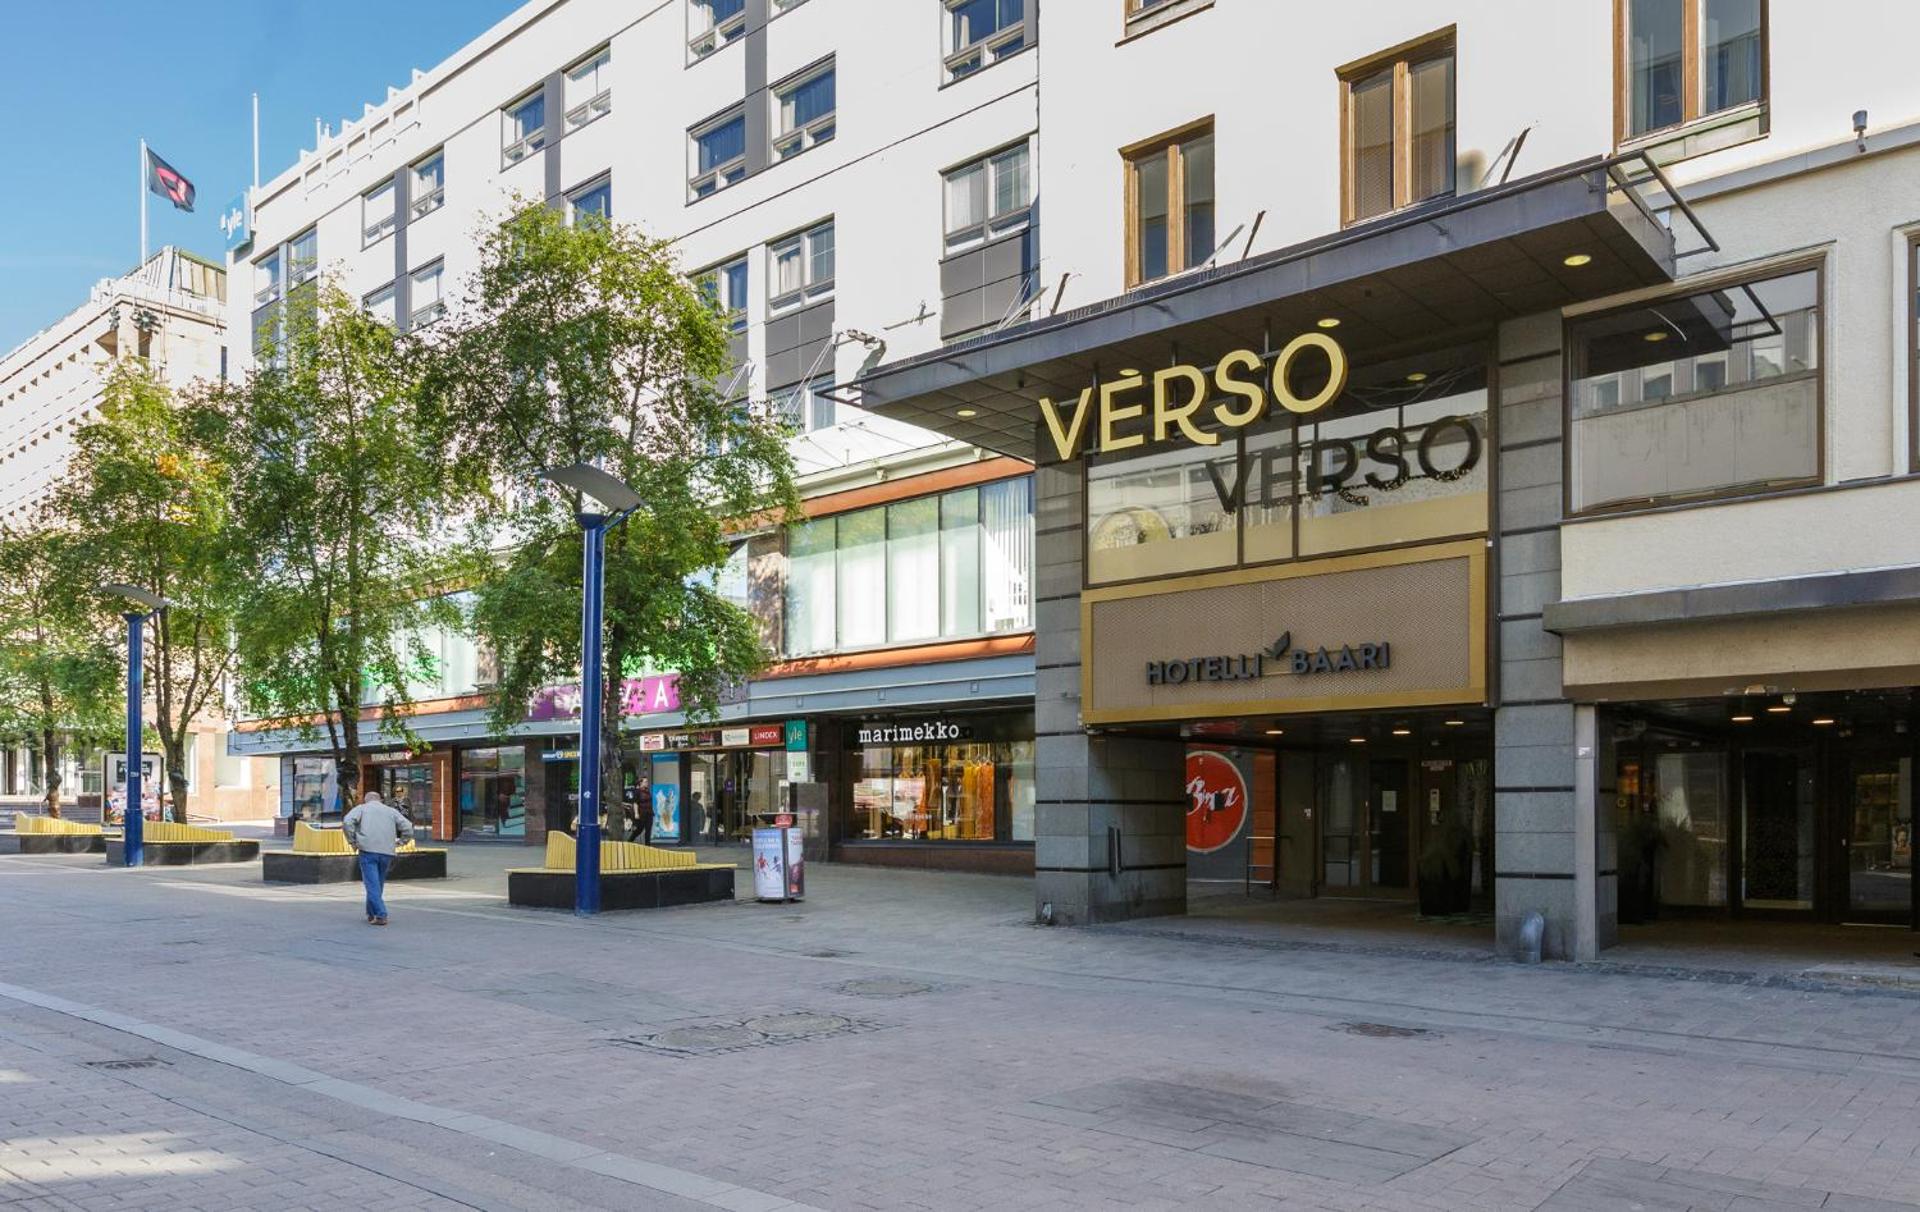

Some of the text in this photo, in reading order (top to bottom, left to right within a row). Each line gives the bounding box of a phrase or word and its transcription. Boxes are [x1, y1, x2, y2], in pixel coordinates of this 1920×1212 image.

[1038, 332, 1348, 461] VERSO
[1145, 641, 1391, 686] HOTELLI BAARI
[753, 731, 778, 740] LINDEX
[787, 726, 802, 744] yle
[858, 721, 960, 743] marimekko
